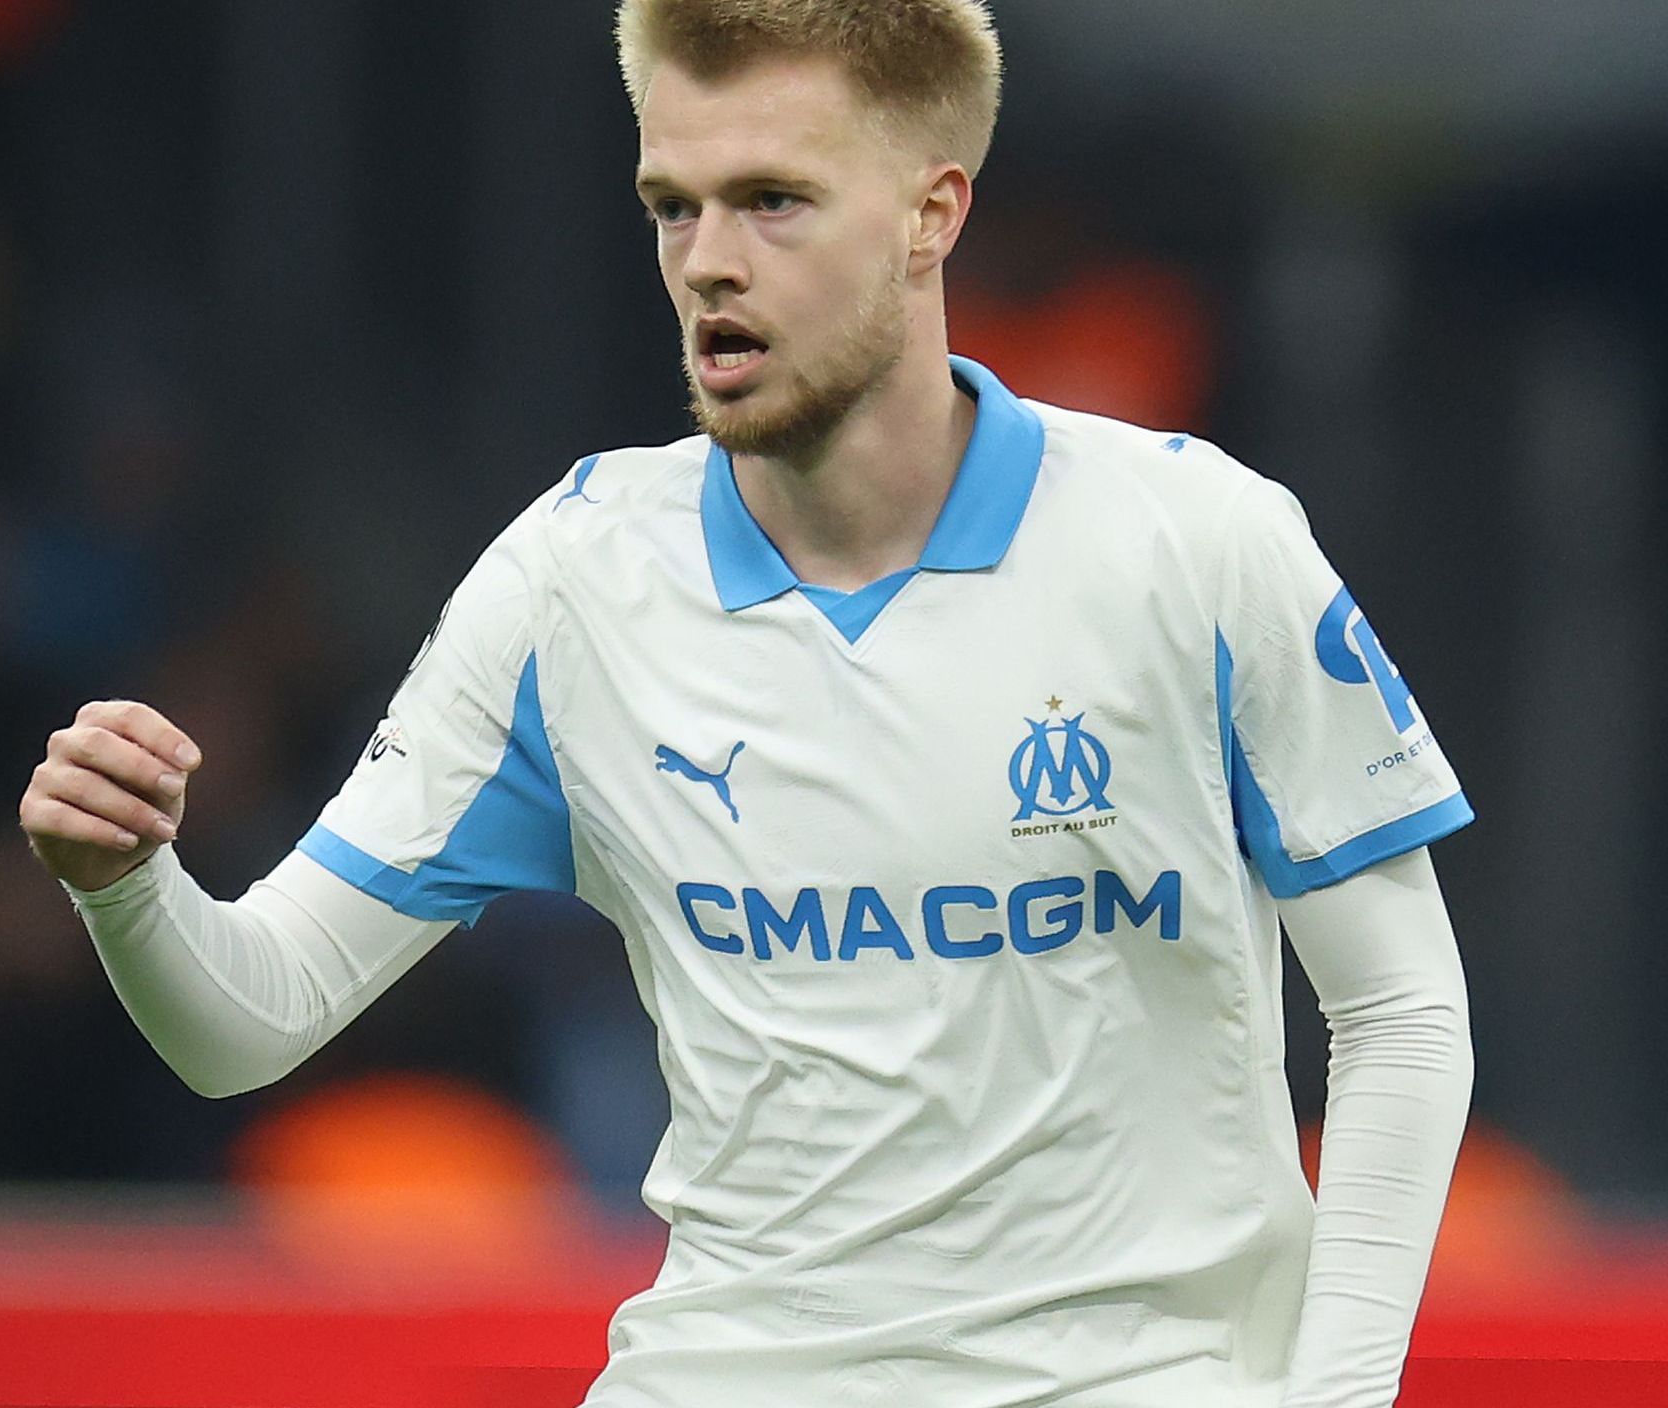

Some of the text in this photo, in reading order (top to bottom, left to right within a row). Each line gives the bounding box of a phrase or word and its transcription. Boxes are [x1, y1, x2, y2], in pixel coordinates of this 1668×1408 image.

[1366, 752, 1407, 776] D'OR
[1408, 741, 1424, 757] ET
[1011, 816, 1118, 837] DROIT AU BUT
